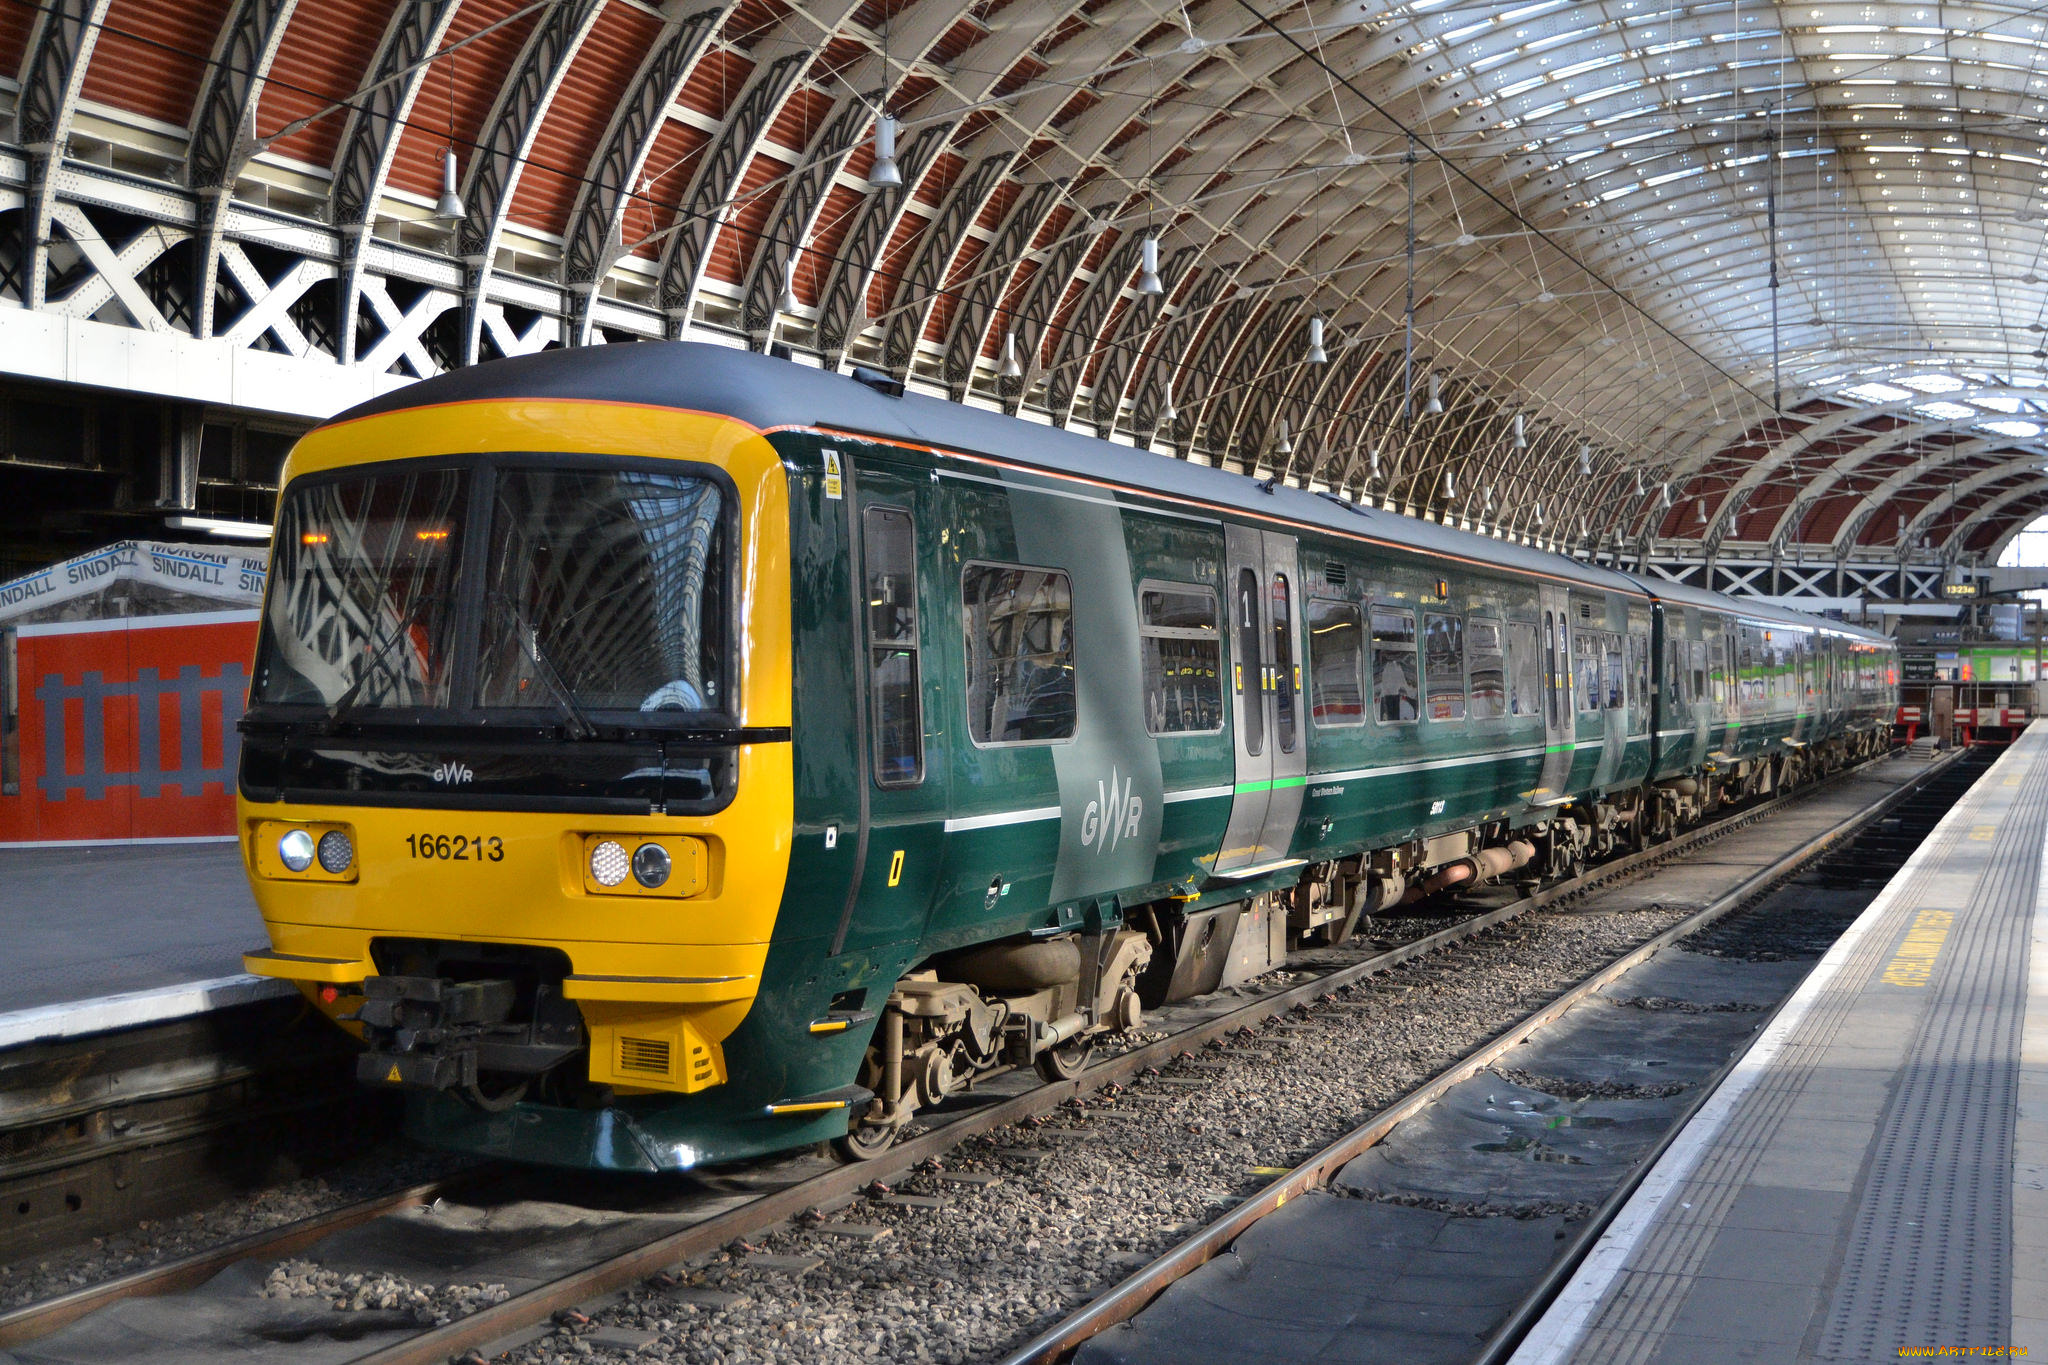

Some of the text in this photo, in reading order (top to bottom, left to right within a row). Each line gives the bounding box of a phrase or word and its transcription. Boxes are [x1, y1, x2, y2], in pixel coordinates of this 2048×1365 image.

[153, 557, 224, 586] SINDALL
[1242, 590, 1251, 627] 1
[424, 760, 474, 785] GWR
[1081, 764, 1143, 855] GWR
[406, 833, 504, 862] 166213
